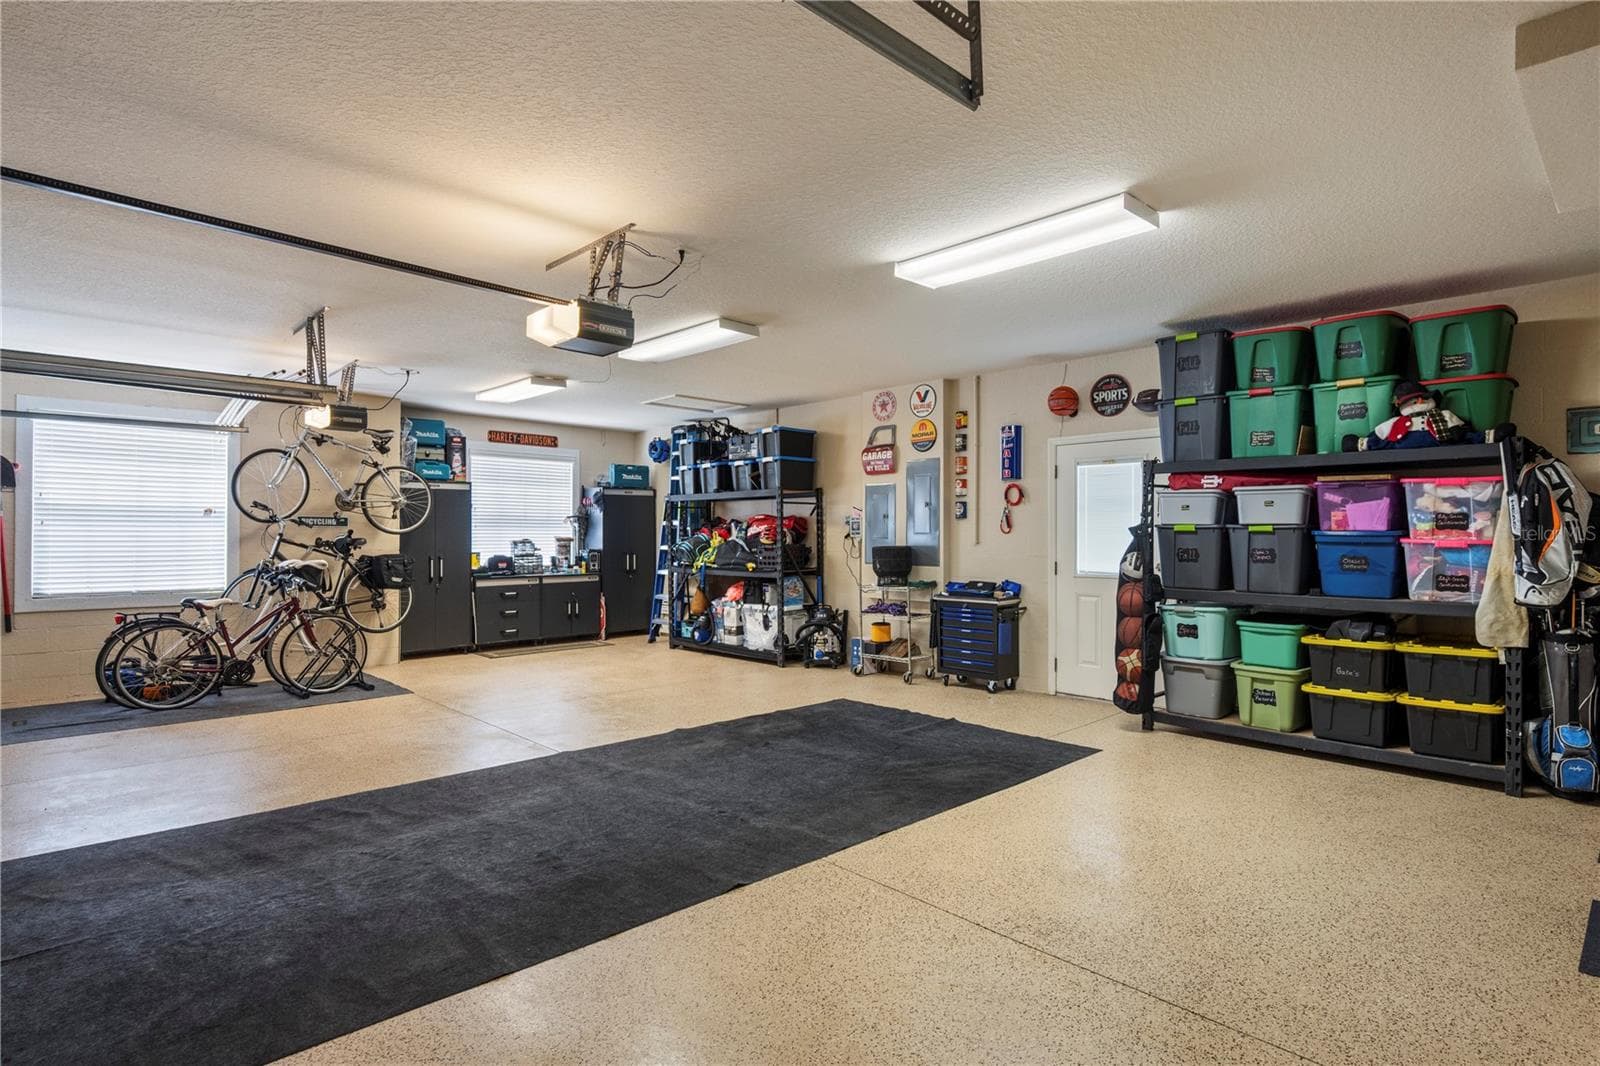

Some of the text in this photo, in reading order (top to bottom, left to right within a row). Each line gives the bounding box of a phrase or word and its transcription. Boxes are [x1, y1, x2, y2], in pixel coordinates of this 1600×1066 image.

[1093, 388, 1129, 404] SPORTS
[863, 451, 893, 460] GARAGE
[1179, 549, 1197, 560] Fall
